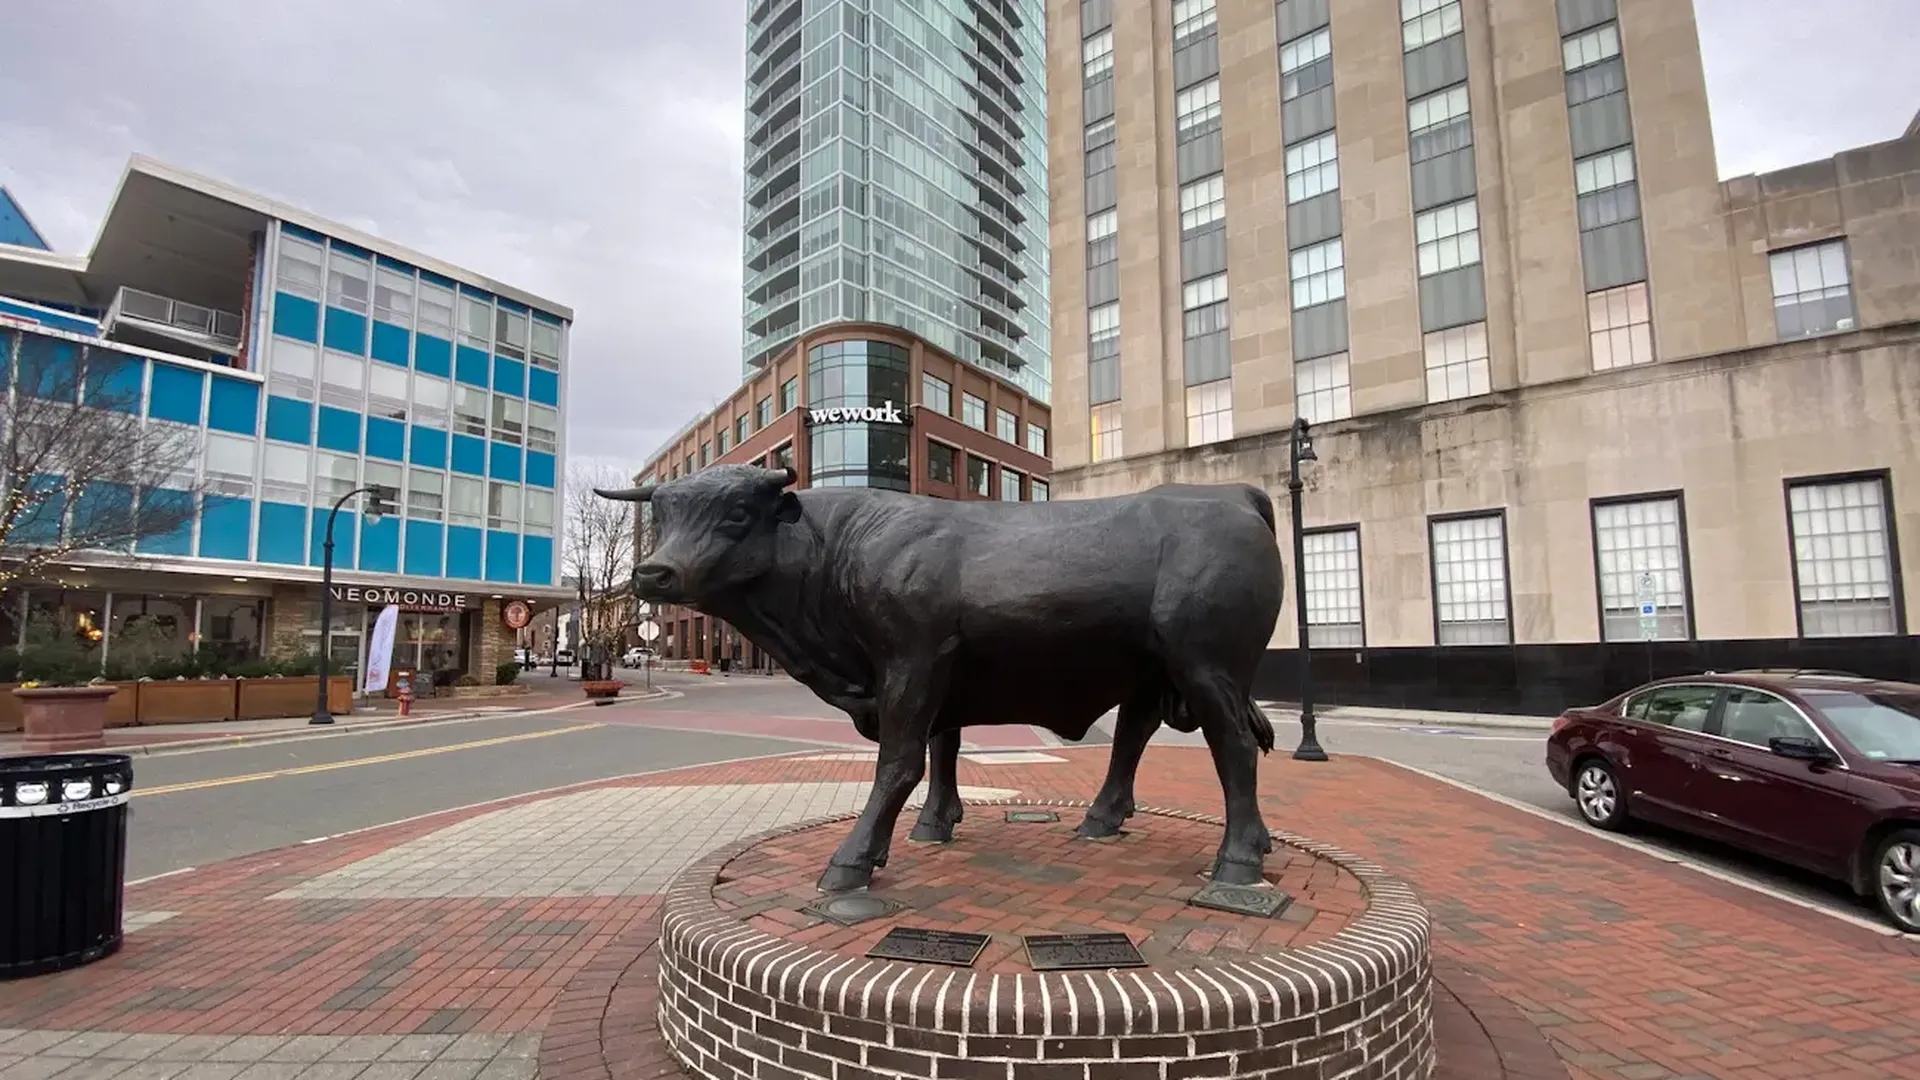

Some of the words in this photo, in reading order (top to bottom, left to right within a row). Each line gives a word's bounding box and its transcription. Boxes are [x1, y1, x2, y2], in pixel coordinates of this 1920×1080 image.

[809, 400, 903, 424] wework
[330, 587, 466, 607] NEOMONDE
[72, 799, 109, 810] Recycle
